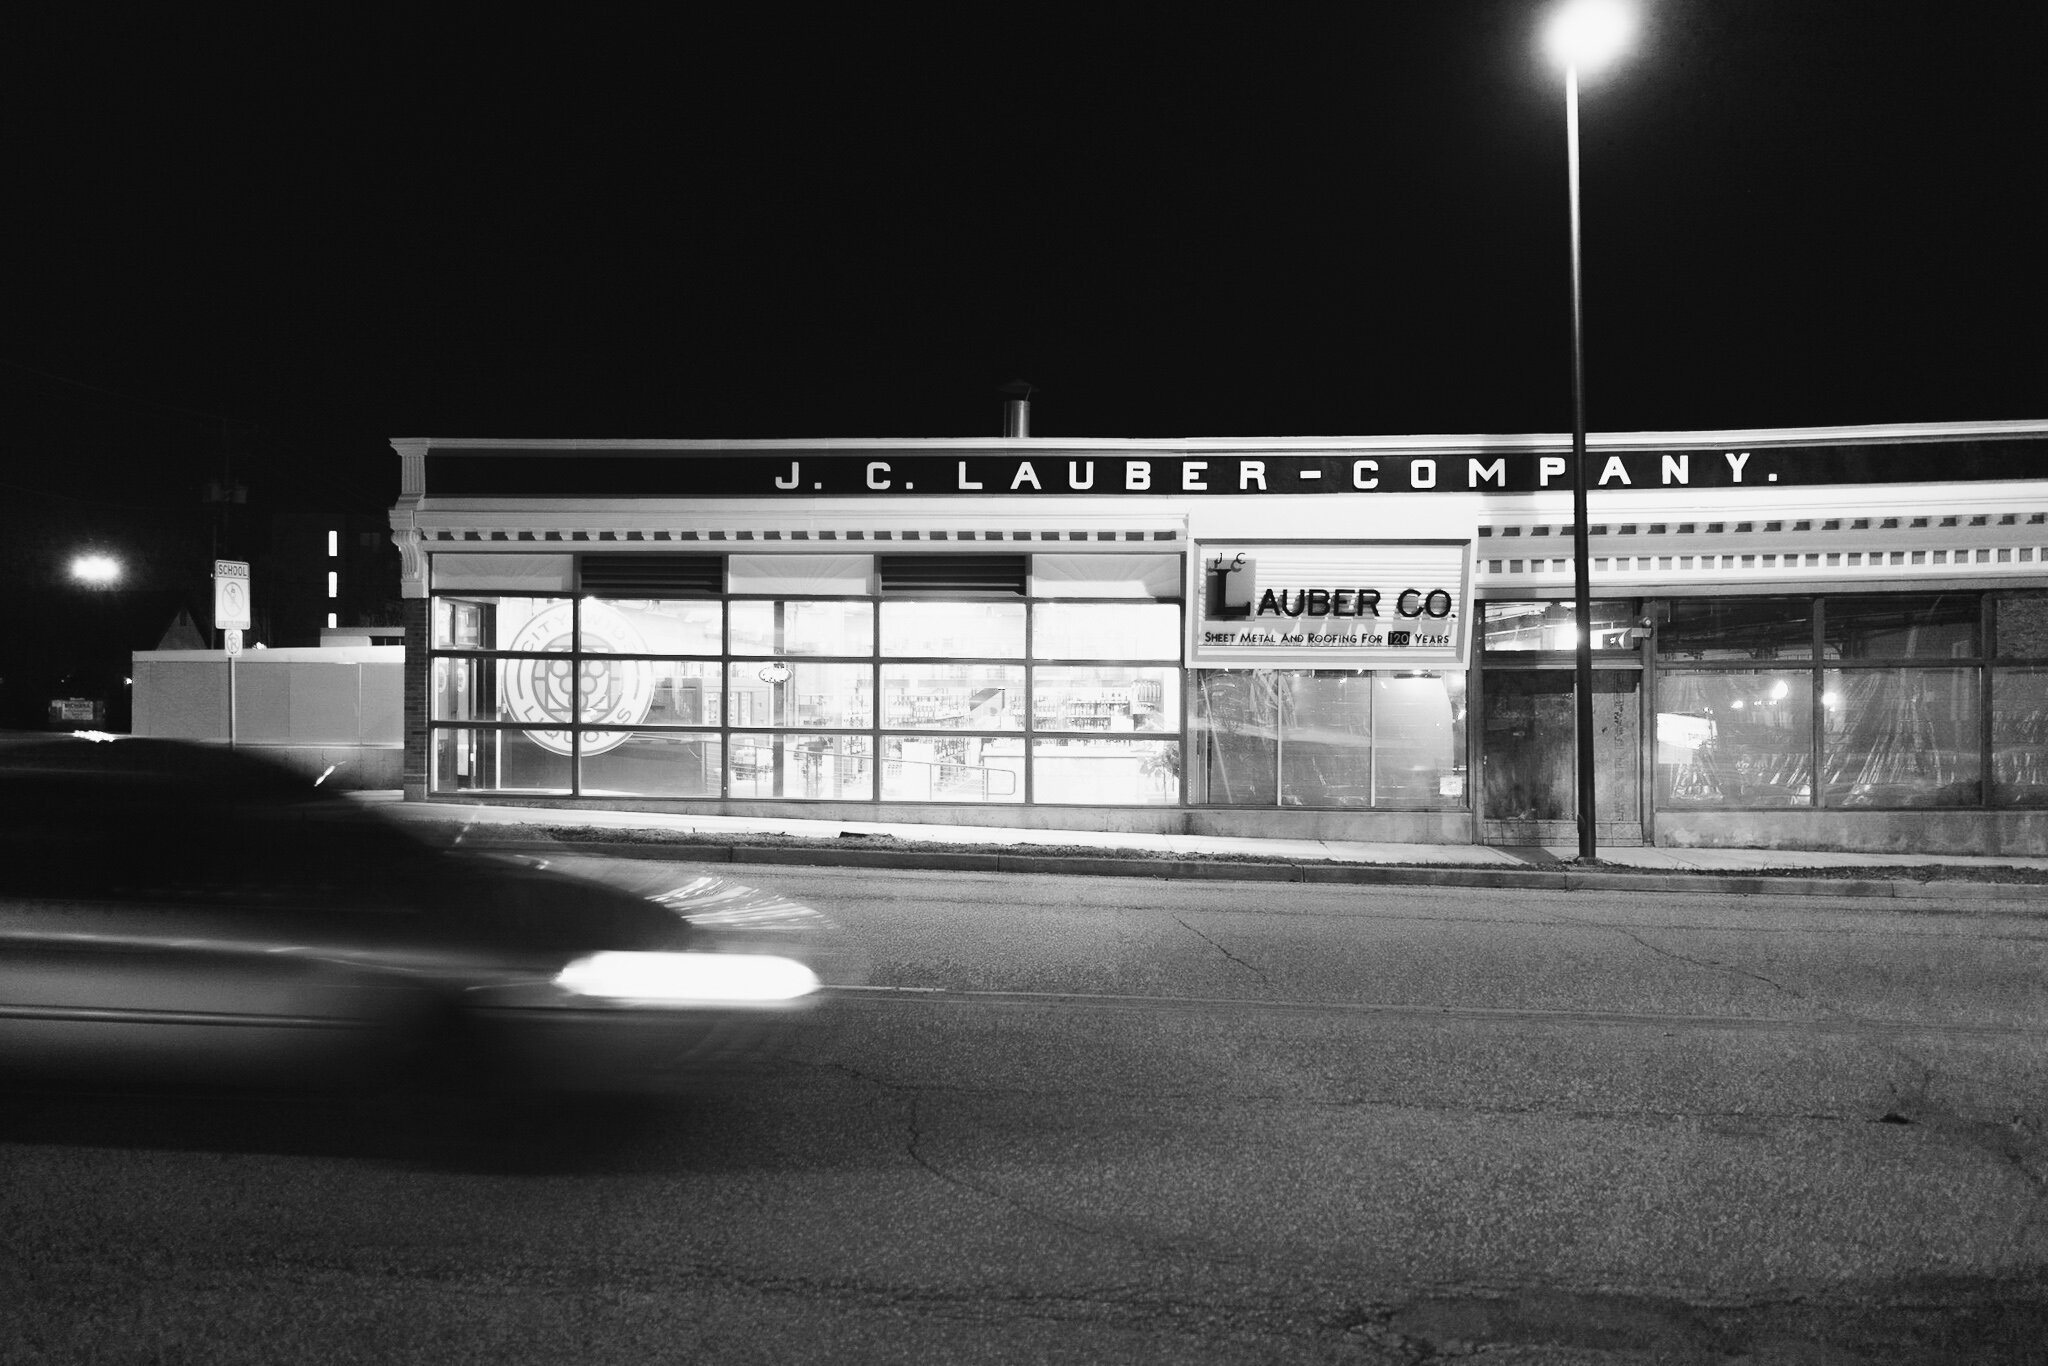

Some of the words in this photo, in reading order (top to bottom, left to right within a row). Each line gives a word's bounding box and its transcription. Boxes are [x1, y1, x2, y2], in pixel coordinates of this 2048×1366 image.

[218, 564, 247, 577] SCHOOL
[1396, 588, 1457, 619] CO.
[521, 613, 567, 651] CITY
[1204, 631, 1236, 643] SHEET
[1240, 632, 1276, 643] METAL
[1281, 632, 1304, 643] AND
[1307, 632, 1358, 644] ROOFING
[1361, 633, 1383, 644] FOR
[1388, 631, 1410, 645] 120
[1414, 633, 1450, 644] YEARS
